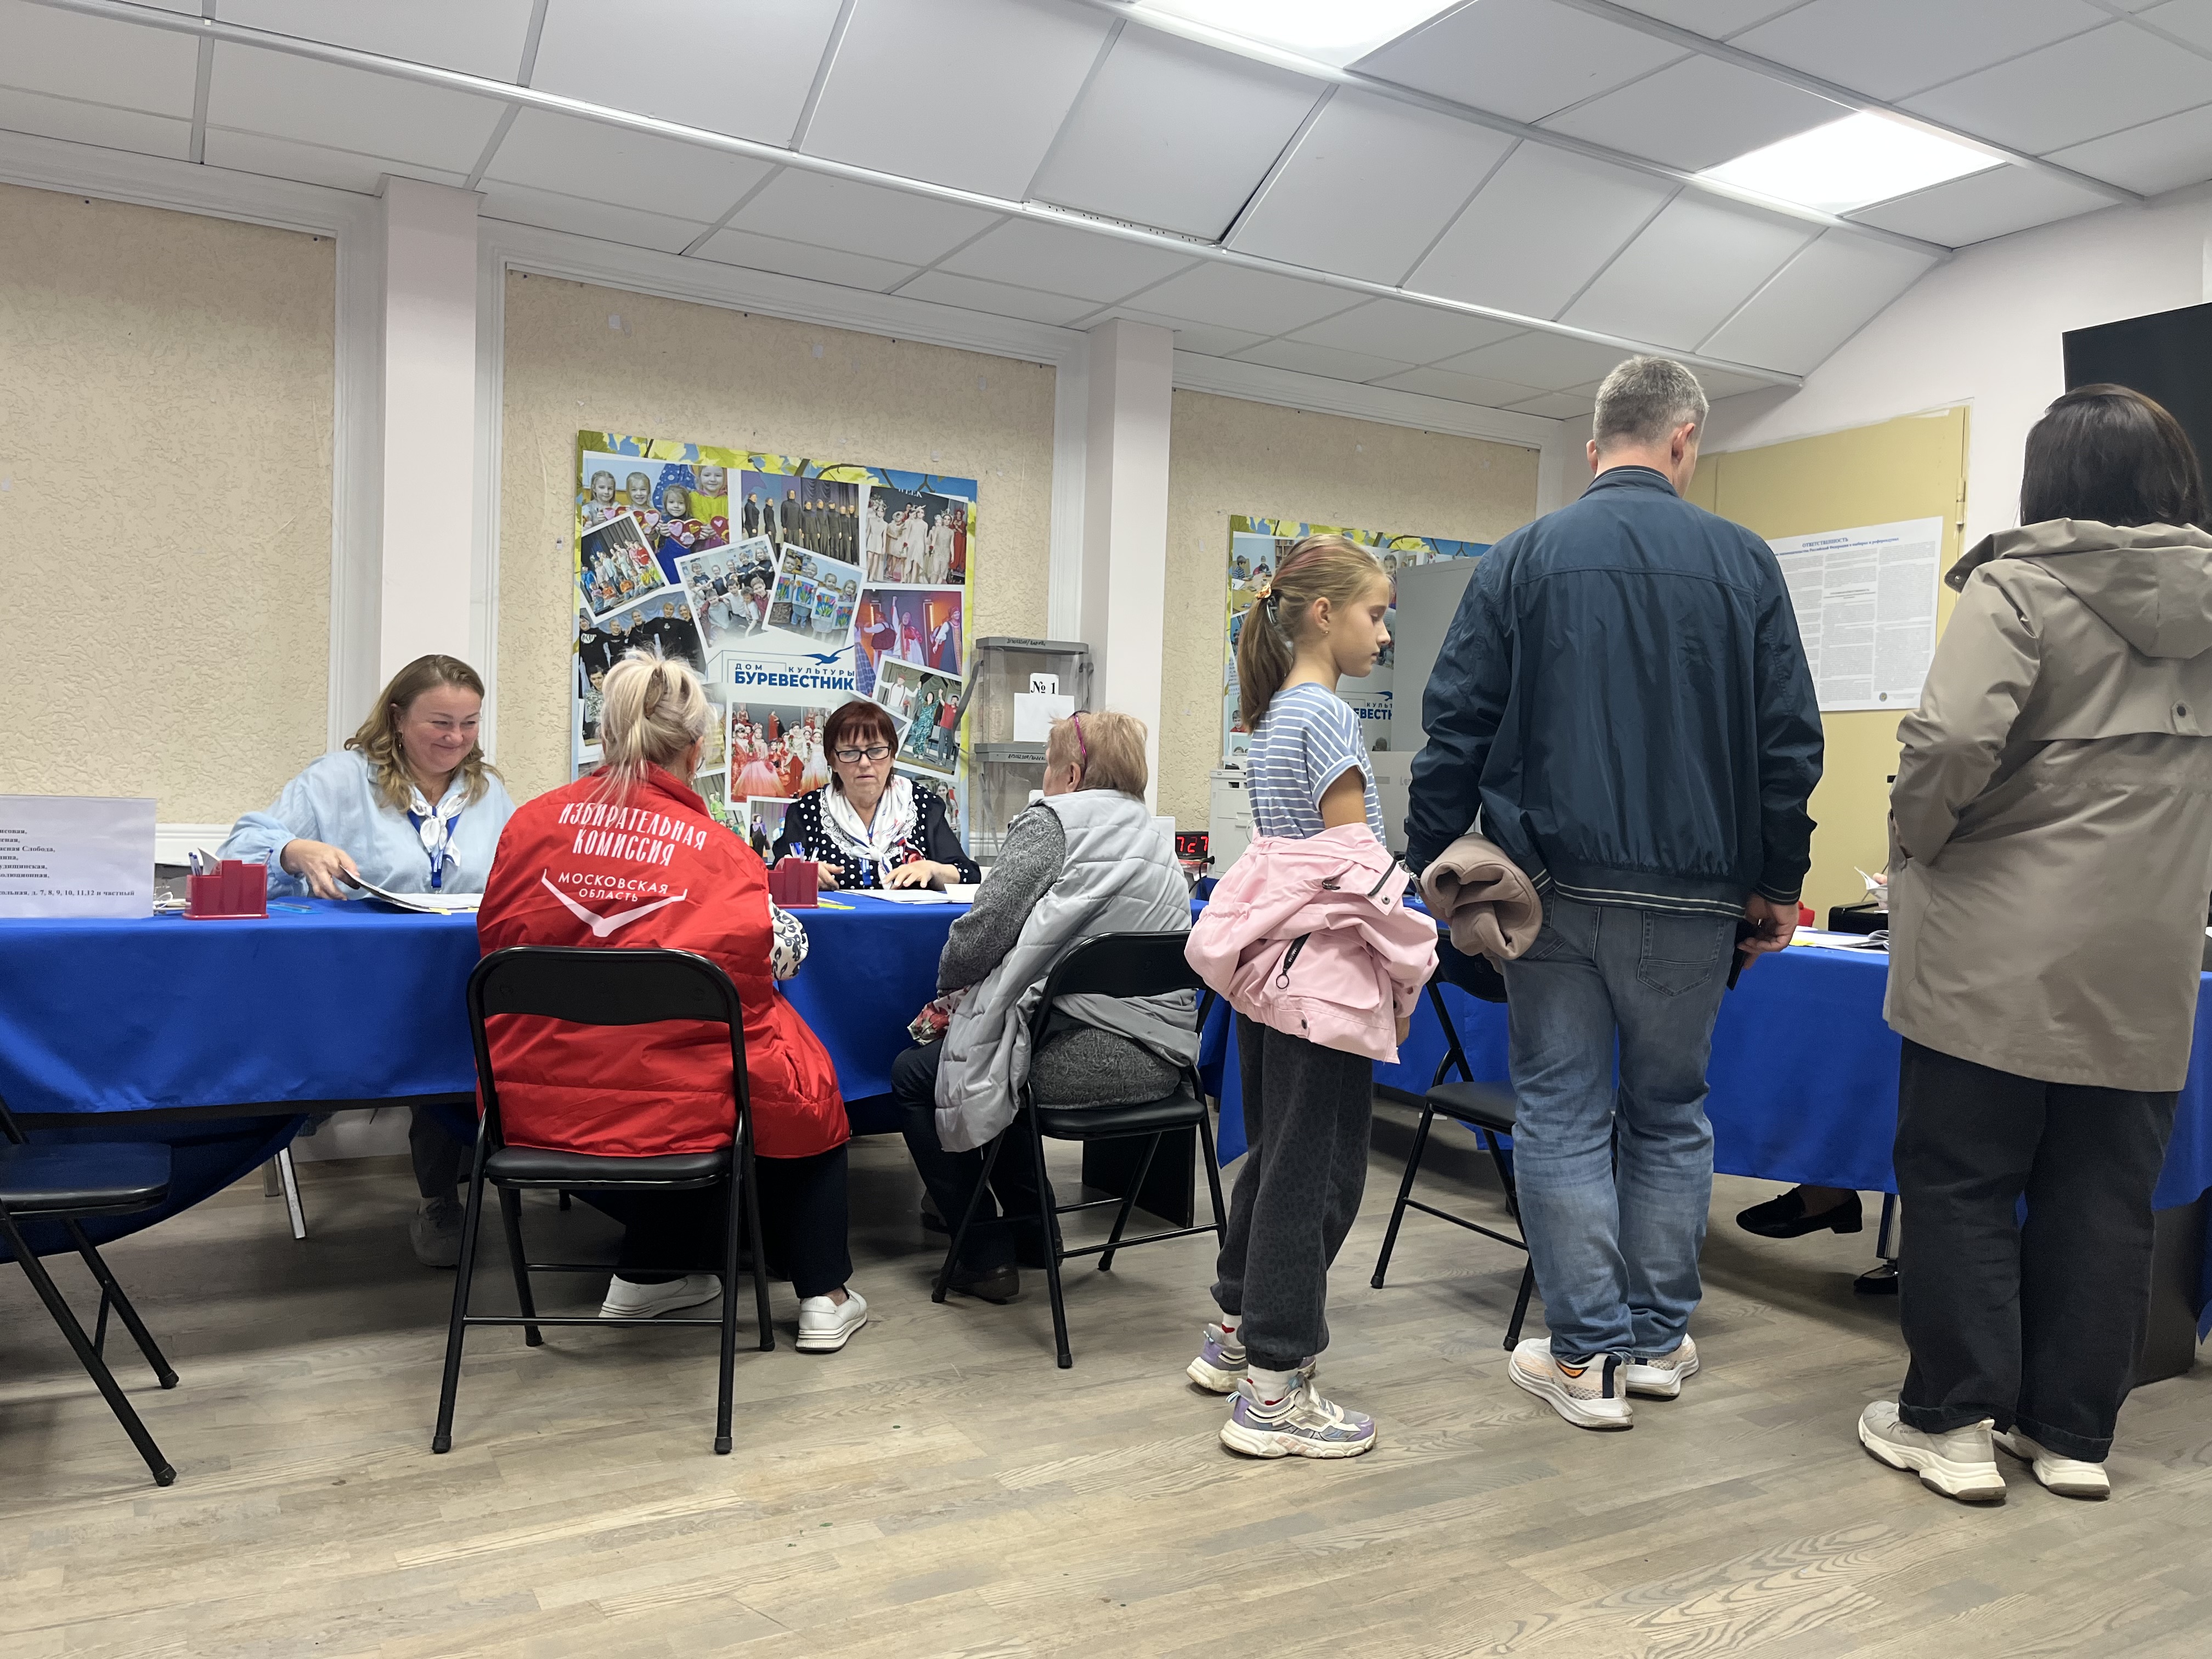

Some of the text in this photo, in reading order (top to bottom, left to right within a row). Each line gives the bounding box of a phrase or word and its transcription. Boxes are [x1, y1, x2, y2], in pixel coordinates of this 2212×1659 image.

[735, 671, 854, 691] БУРЕВЕСТНИК
[788, 667, 855, 676] КУЛЬТУРЫ
[1031, 681, 1056, 695] № 1
[558, 803, 707, 851] ИЗБИРАТЕЛЬНАЯ
[572, 829, 675, 866] КОМИССИЯ
[558, 872, 669, 894] МОСКОВСКАЯ
[579, 888, 638, 902] ОБЛАСТЬ
